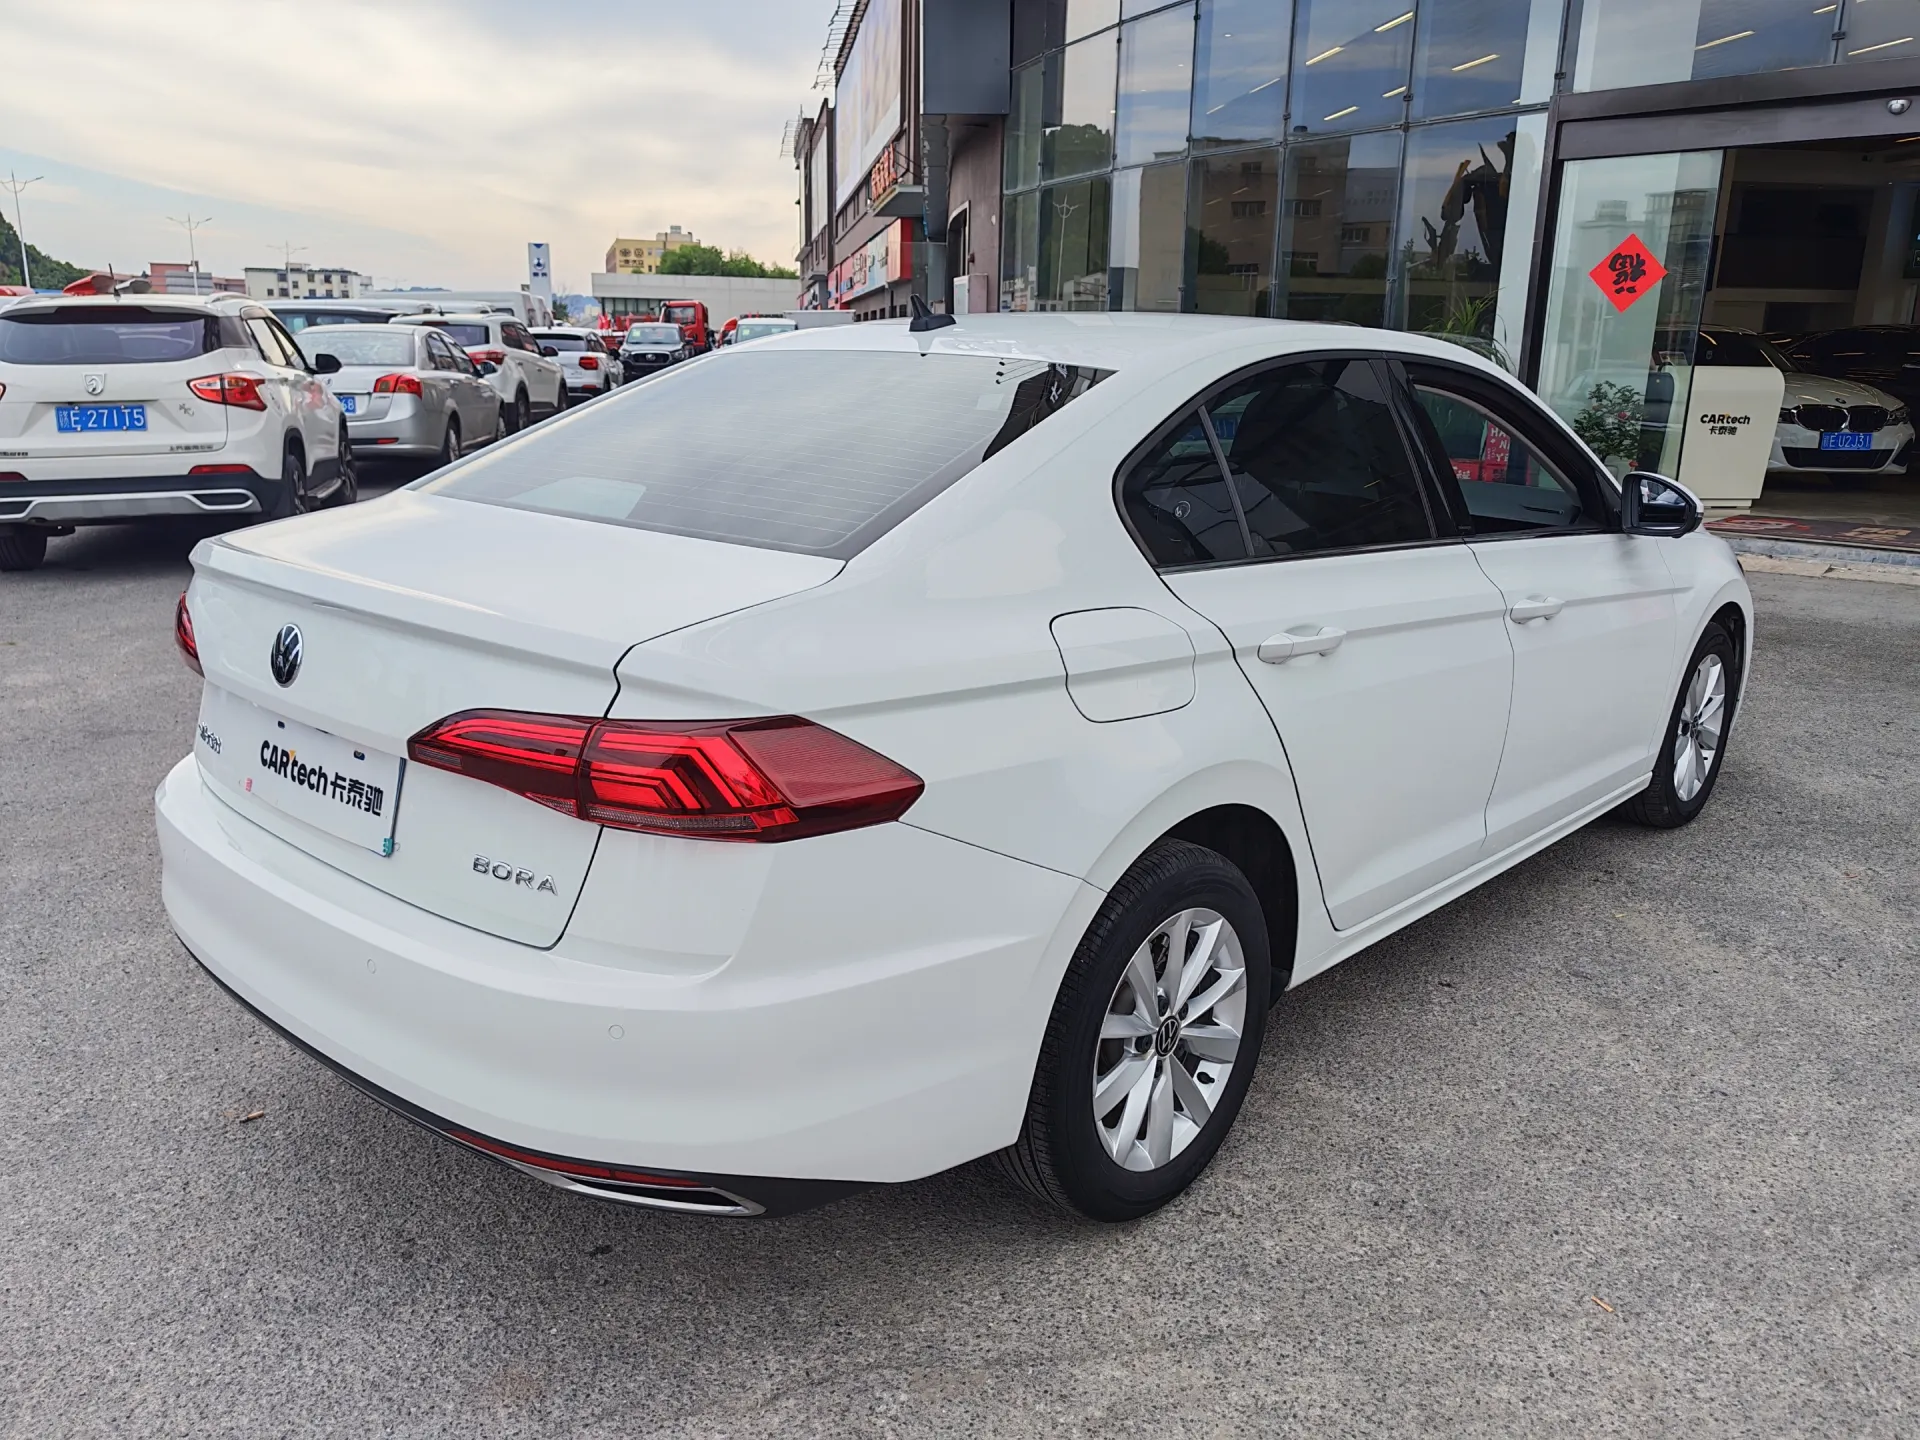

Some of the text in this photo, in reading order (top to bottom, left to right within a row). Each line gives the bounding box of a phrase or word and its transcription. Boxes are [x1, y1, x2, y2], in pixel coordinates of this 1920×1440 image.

[1700, 413, 1750, 425] CARtech
[260, 740, 384, 817] CARtech 卡泰驰
[472, 853, 559, 896] BORA
